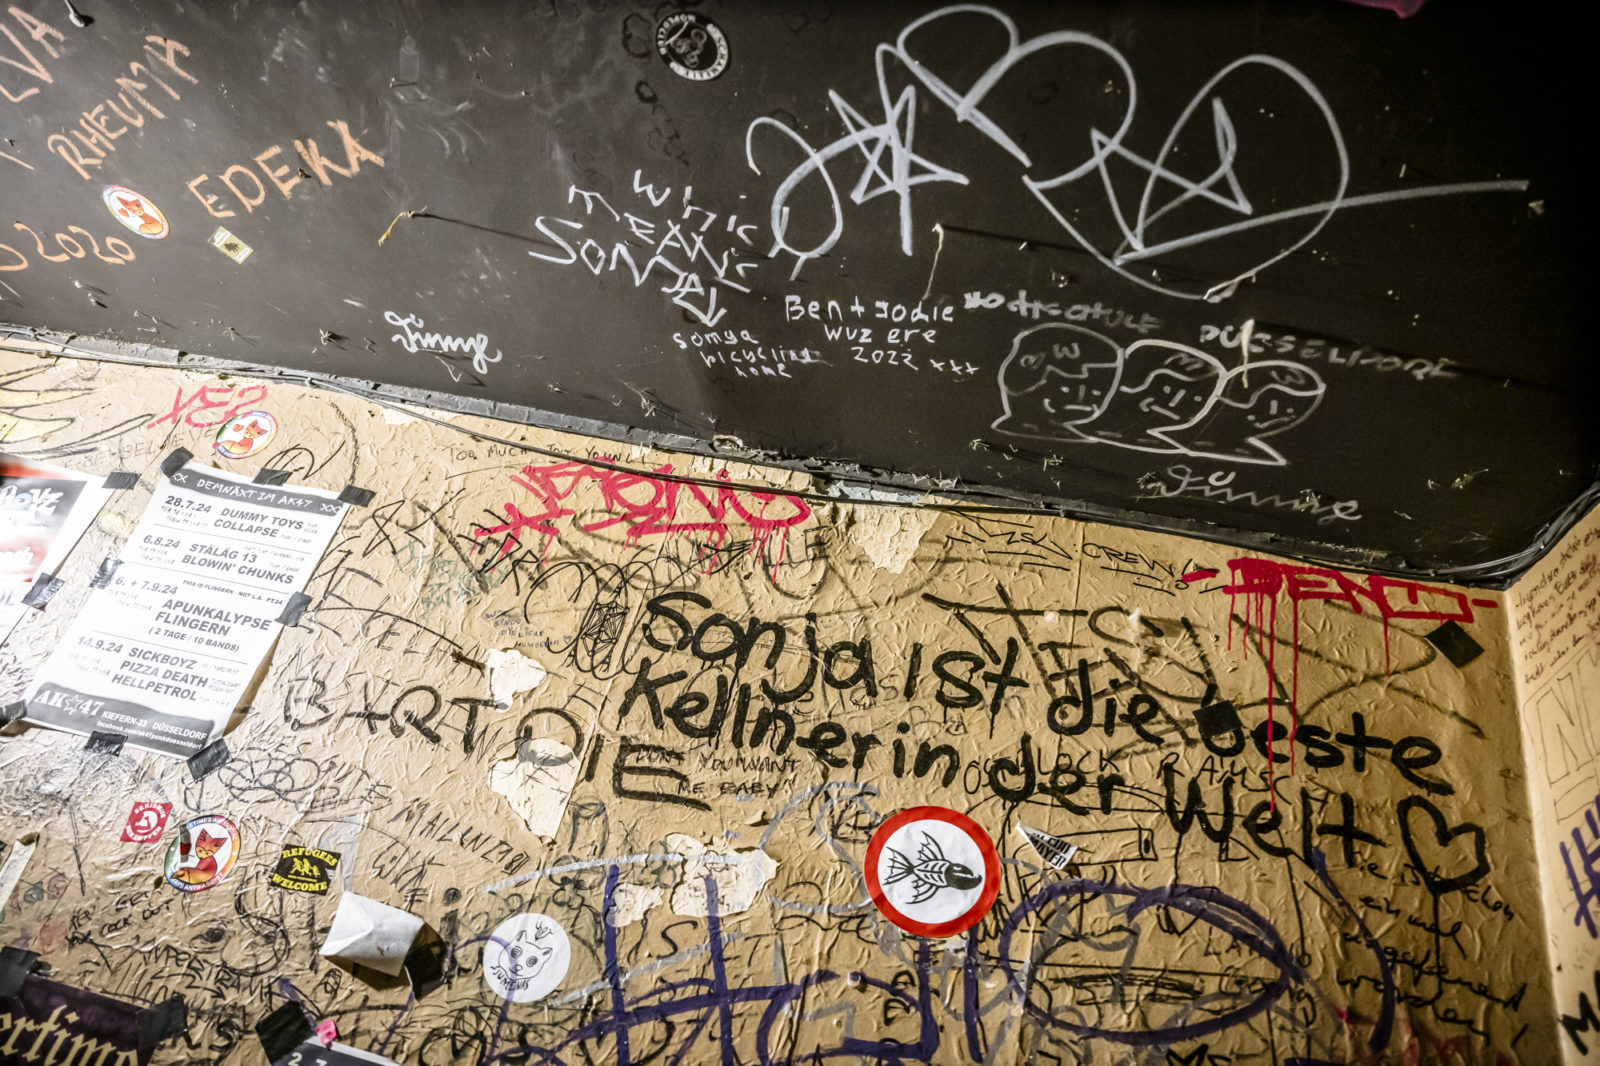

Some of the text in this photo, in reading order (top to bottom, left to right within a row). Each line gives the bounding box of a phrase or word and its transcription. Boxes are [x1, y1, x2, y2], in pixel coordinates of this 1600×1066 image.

[48, 35, 199, 180] RHEUMA
[187, 120, 384, 217] EDEKA
[14, 221, 135, 264] 2020
[785, 295, 845, 322] Ben
[888, 328, 937, 344] ere
[850, 346, 919, 370] 2022
[165, 495, 212, 514] 28.7.24
[196, 478, 258, 501] DEMNÄXT
[257, 491, 276, 502] IM
[278, 495, 313, 508] AK47
[214, 519, 280, 538] COLLAPSE
[220, 508, 270, 525] DUMMY
[271, 517, 304, 530] TOYS
[143, 534, 181, 550] 6.8.24
[189, 542, 239, 560] STÄLÄG
[241, 552, 258, 563] 13
[181, 555, 237, 572] BLOWIN'
[237, 565, 295, 584] CHUNKS
[141, 580, 178, 595] 7.9.24
[203, 584, 233, 595] FLINGERN
[155, 611, 231, 637] FLINGERN
[161, 599, 272, 631] APUNKALYPSE
[78, 636, 123, 654] 14.9.24
[163, 629, 187, 641] TAGE
[193, 636, 204, 645] 10
[205, 638, 240, 652] BANDS)
[128, 647, 198, 670] SICKBOYZ
[642, 591, 878, 703] Sonja
[1047, 659, 1164, 745] die
[120, 660, 160, 677] PIZZA
[162, 668, 208, 687] DEATH
[111, 673, 197, 701] HELLPETROL
[152, 721, 207, 740] DÜSSELDORF
[618, 657, 1386, 868] Kellnerin der Welt
[282, 847, 338, 866] REFUGEES
[272, 873, 327, 891] WELCOME
